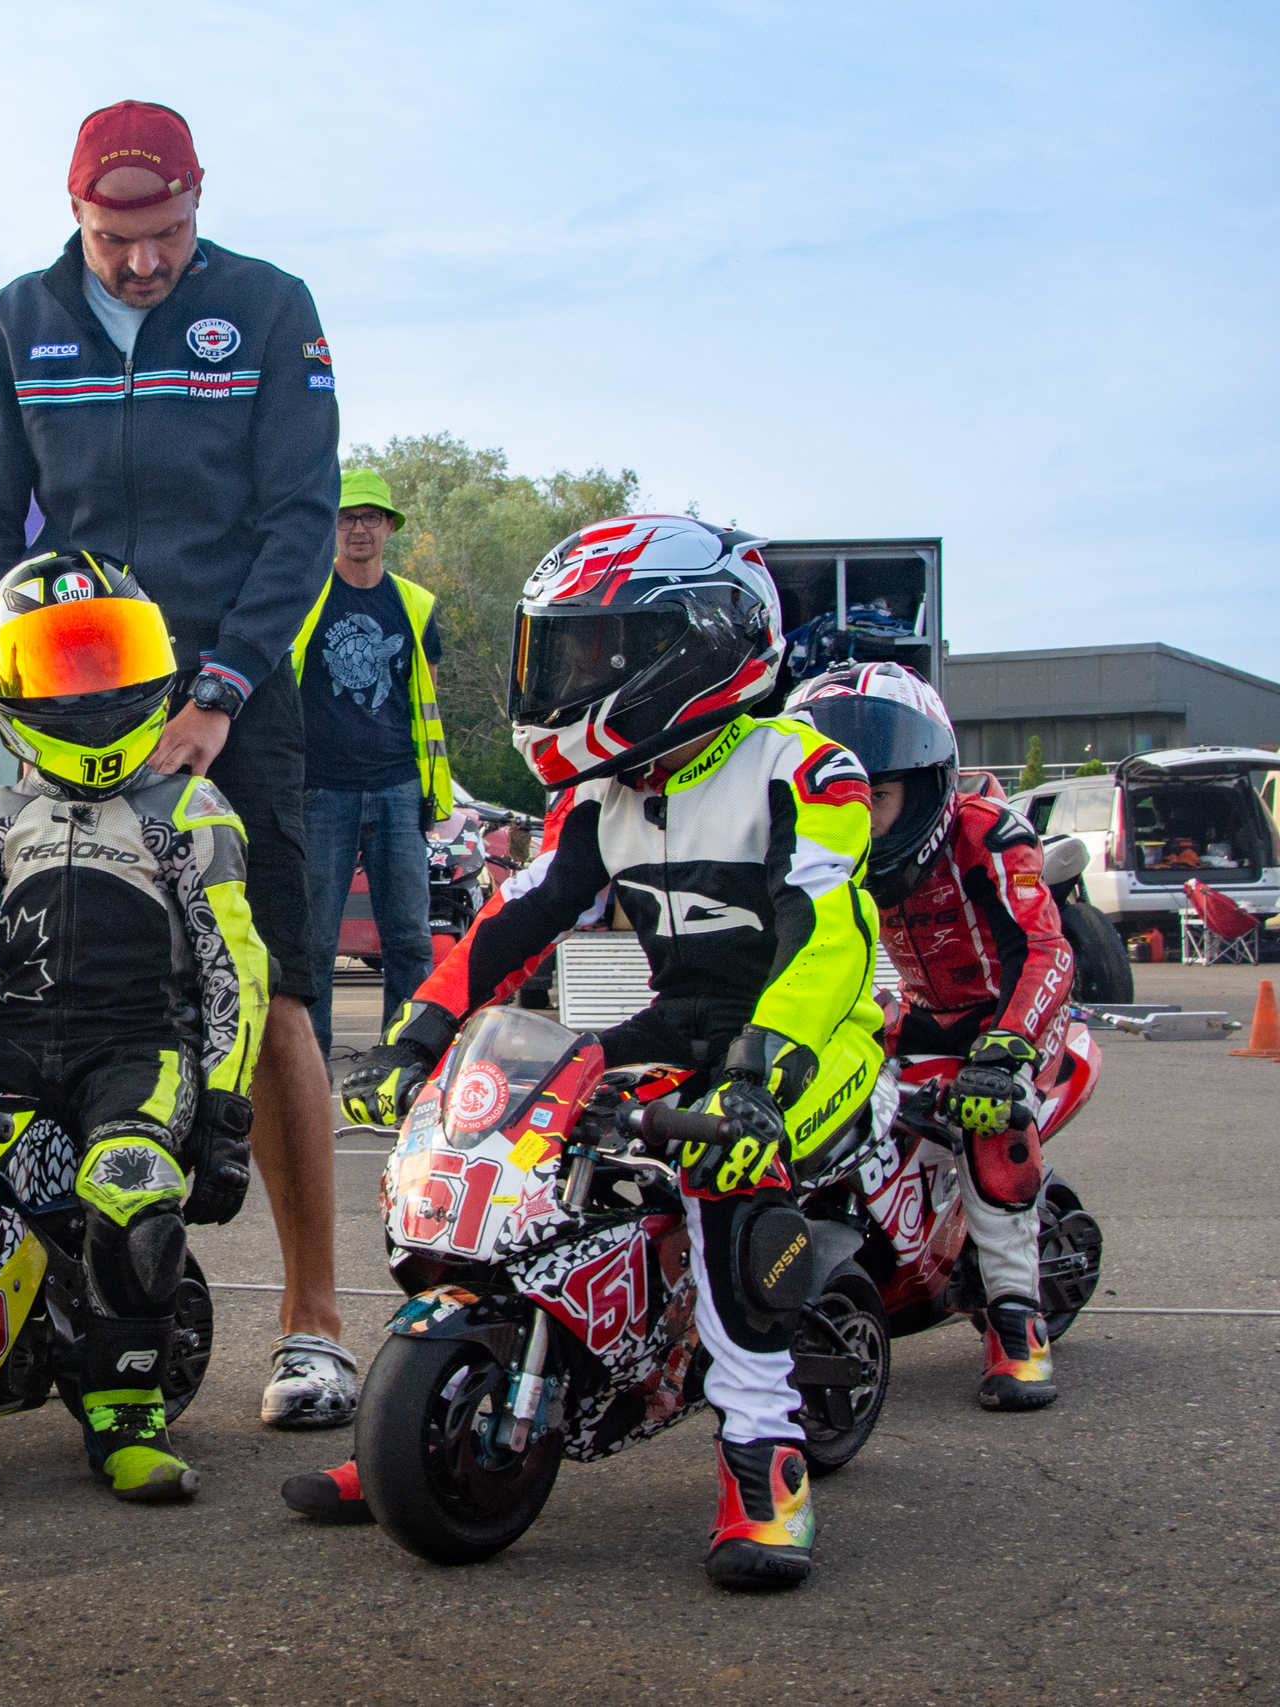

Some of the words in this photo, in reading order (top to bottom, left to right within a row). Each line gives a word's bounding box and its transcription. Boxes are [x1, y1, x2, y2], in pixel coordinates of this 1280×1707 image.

[31, 343, 78, 357] sparco
[189, 371, 231, 383] MARTINI
[189, 387, 230, 398] RACING
[61, 588, 90, 601] agv
[324, 617, 351, 640] SLOW
[328, 625, 359, 650] MOTION
[678, 722, 741, 784] GIMOTO
[80, 748, 128, 789] 19
[15, 840, 141, 864] RECORD
[879, 907, 960, 930] ERG
[1024, 948, 1071, 1034] BERG
[484, 1065, 507, 1098] TAKAYAMA
[414, 1101, 436, 1116] 2026
[482, 1102, 504, 1126] MOTOR
[795, 1064, 867, 1146] GIMOTO
[412, 1116, 434, 1130] 2026
[402, 1151, 502, 1253] 51
[587, 1230, 649, 1355] 51
